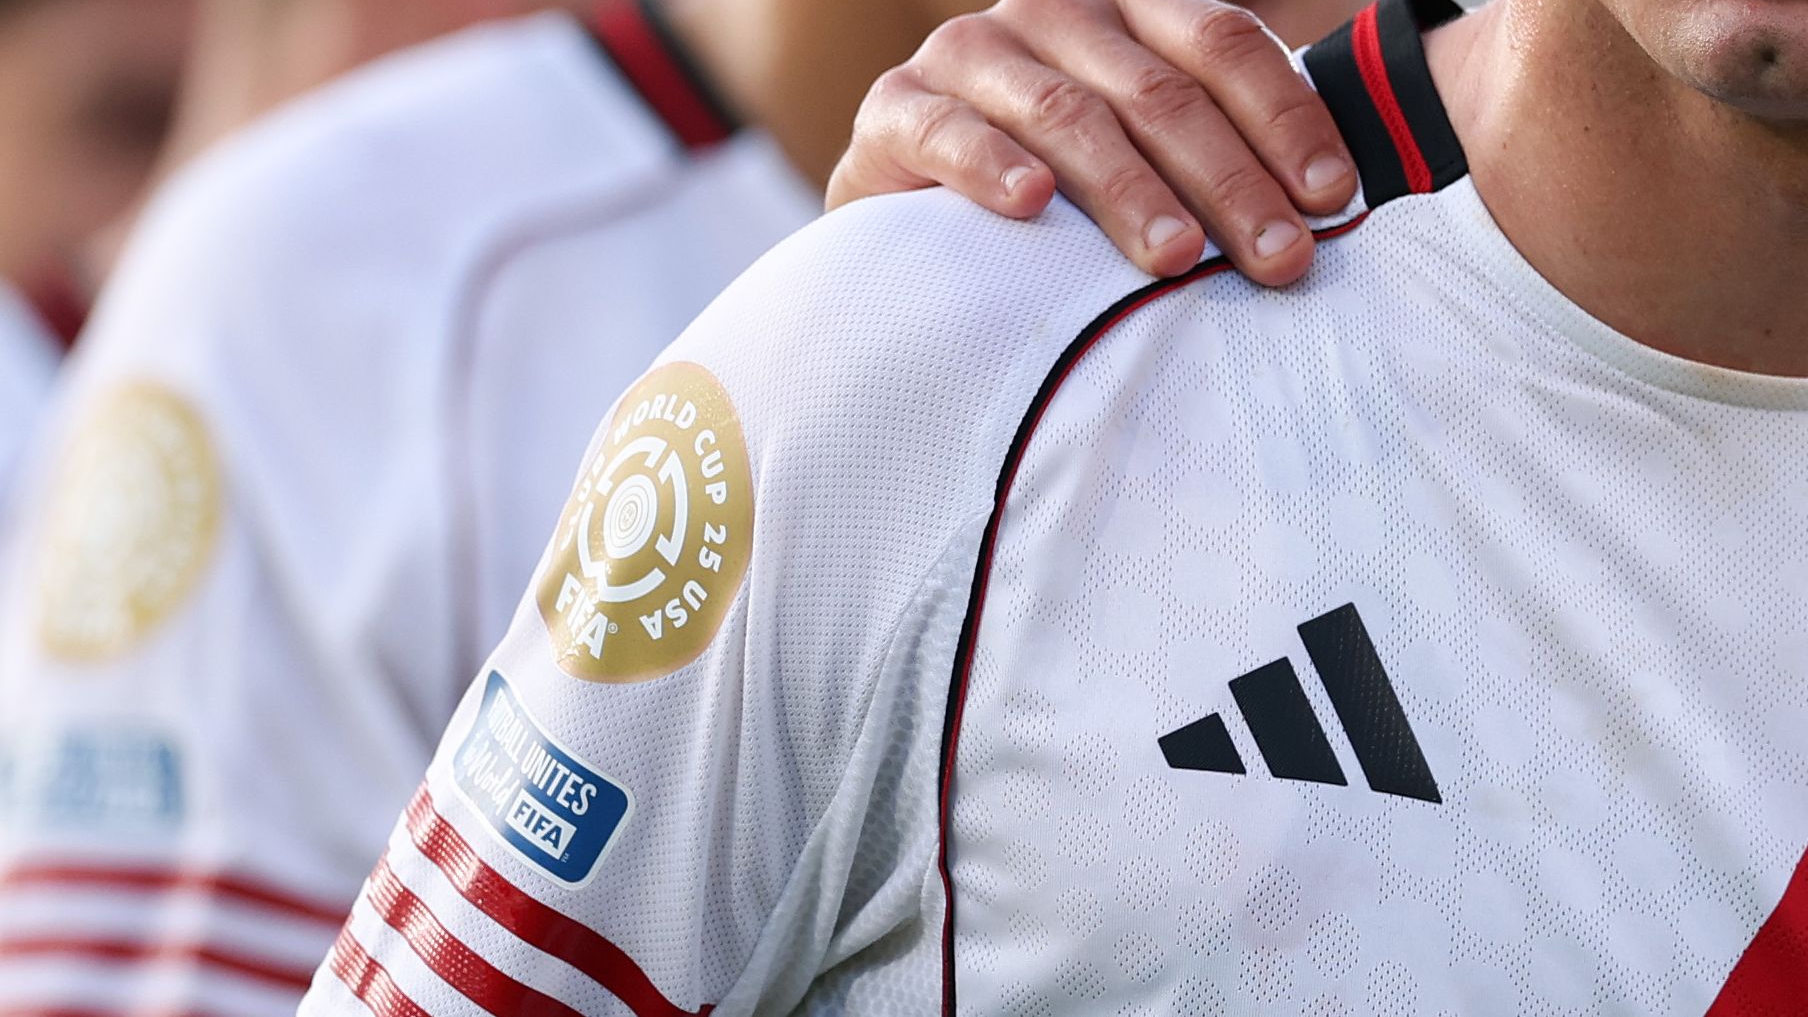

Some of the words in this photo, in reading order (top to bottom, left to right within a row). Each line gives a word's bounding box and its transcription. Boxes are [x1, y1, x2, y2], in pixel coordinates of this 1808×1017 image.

[613, 393, 697, 446] WORLD
[694, 429, 728, 506] CUP
[698, 520, 728, 574] 25
[639, 579, 709, 641] USA
[520, 740, 598, 816] UNITES
[512, 799, 564, 851] FIFA
